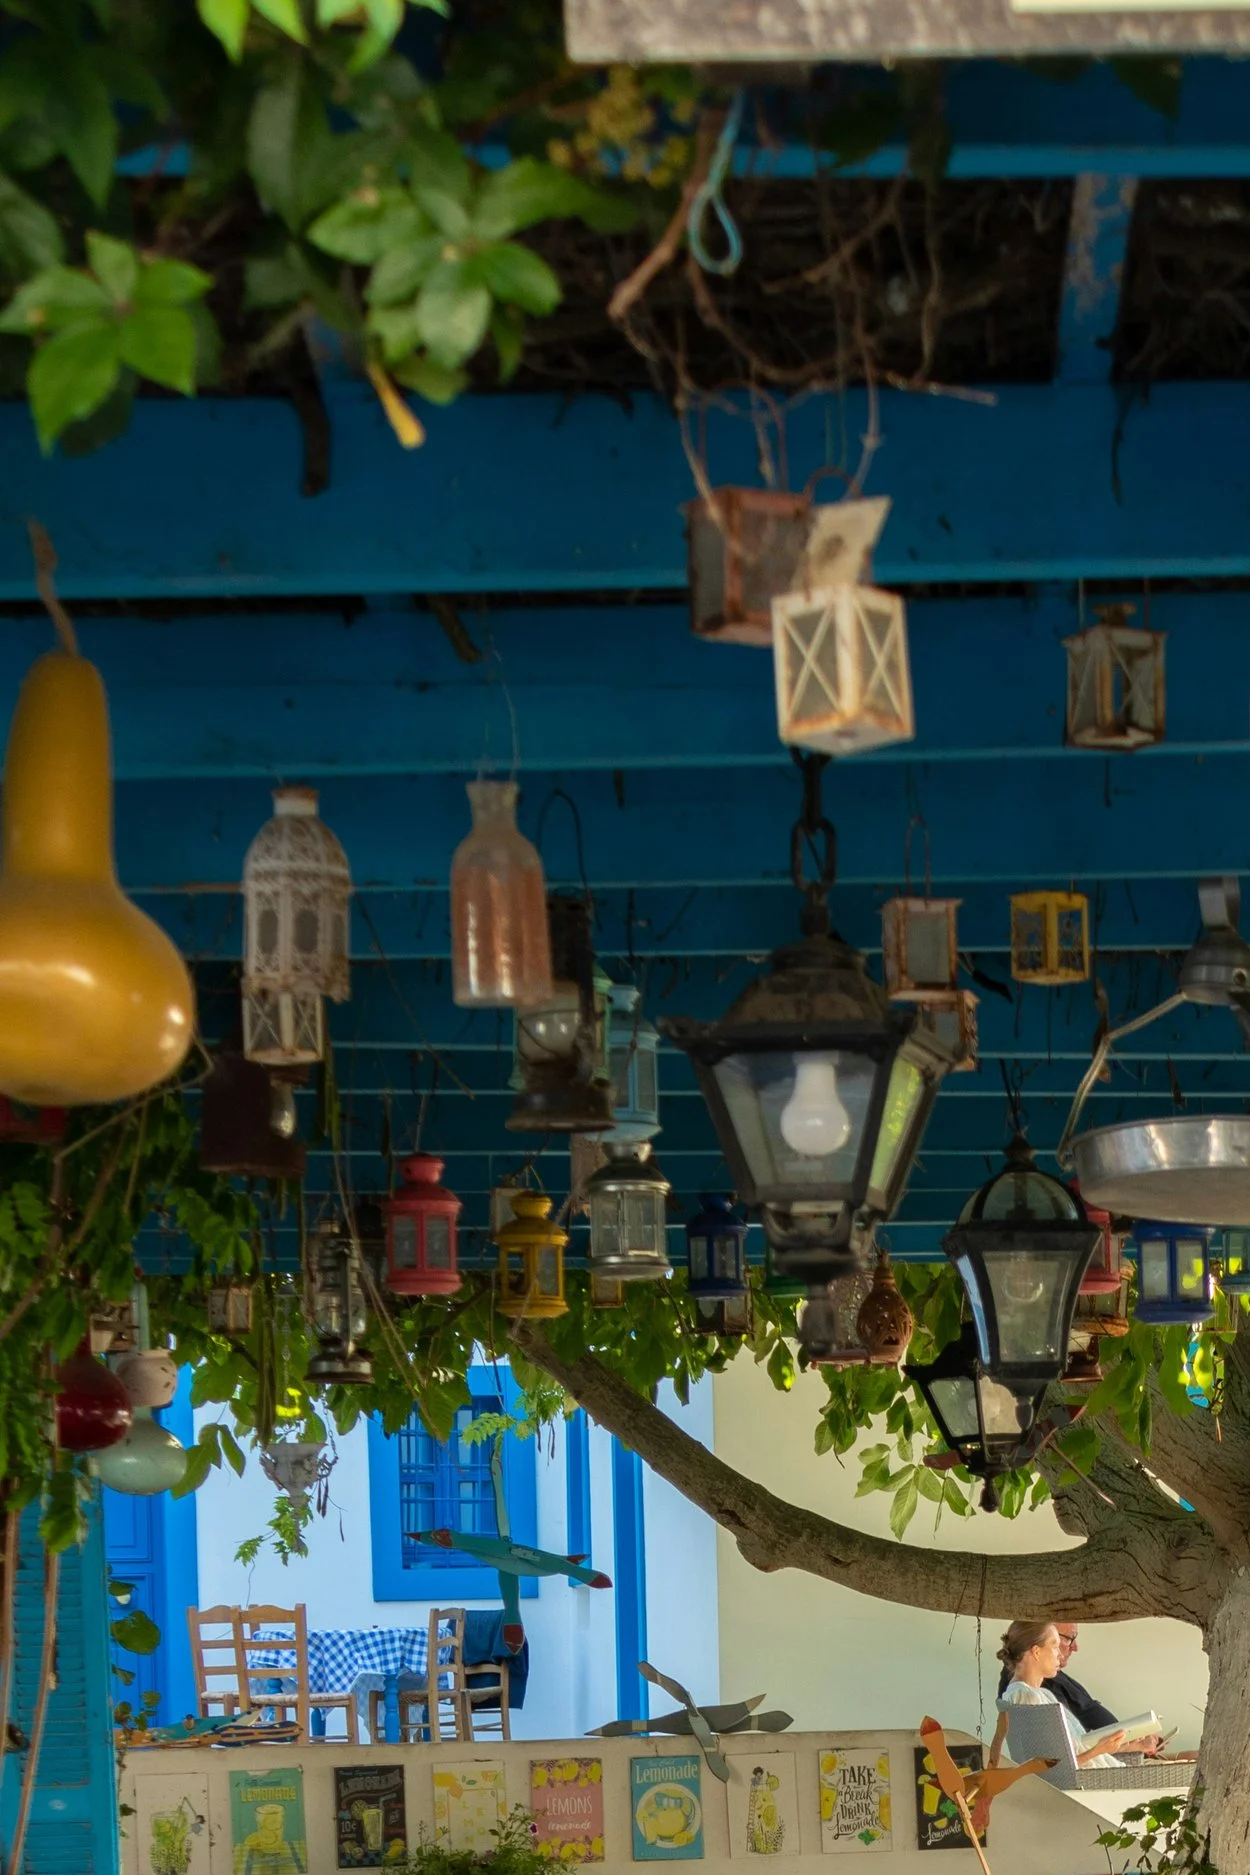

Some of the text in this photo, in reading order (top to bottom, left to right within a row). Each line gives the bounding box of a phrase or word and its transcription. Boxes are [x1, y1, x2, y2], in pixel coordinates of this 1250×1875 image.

[635, 1760, 698, 1785] Lemonade
[839, 1765, 876, 1786] TAKE
[841, 1784, 879, 1805] Break
[546, 1796, 593, 1816] LEMONS
[840, 1802, 872, 1820] DRINK
[548, 1819, 592, 1831] lemonade
[832, 1810, 880, 1840] Lemonade
[922, 1820, 962, 1845] Lemonade
